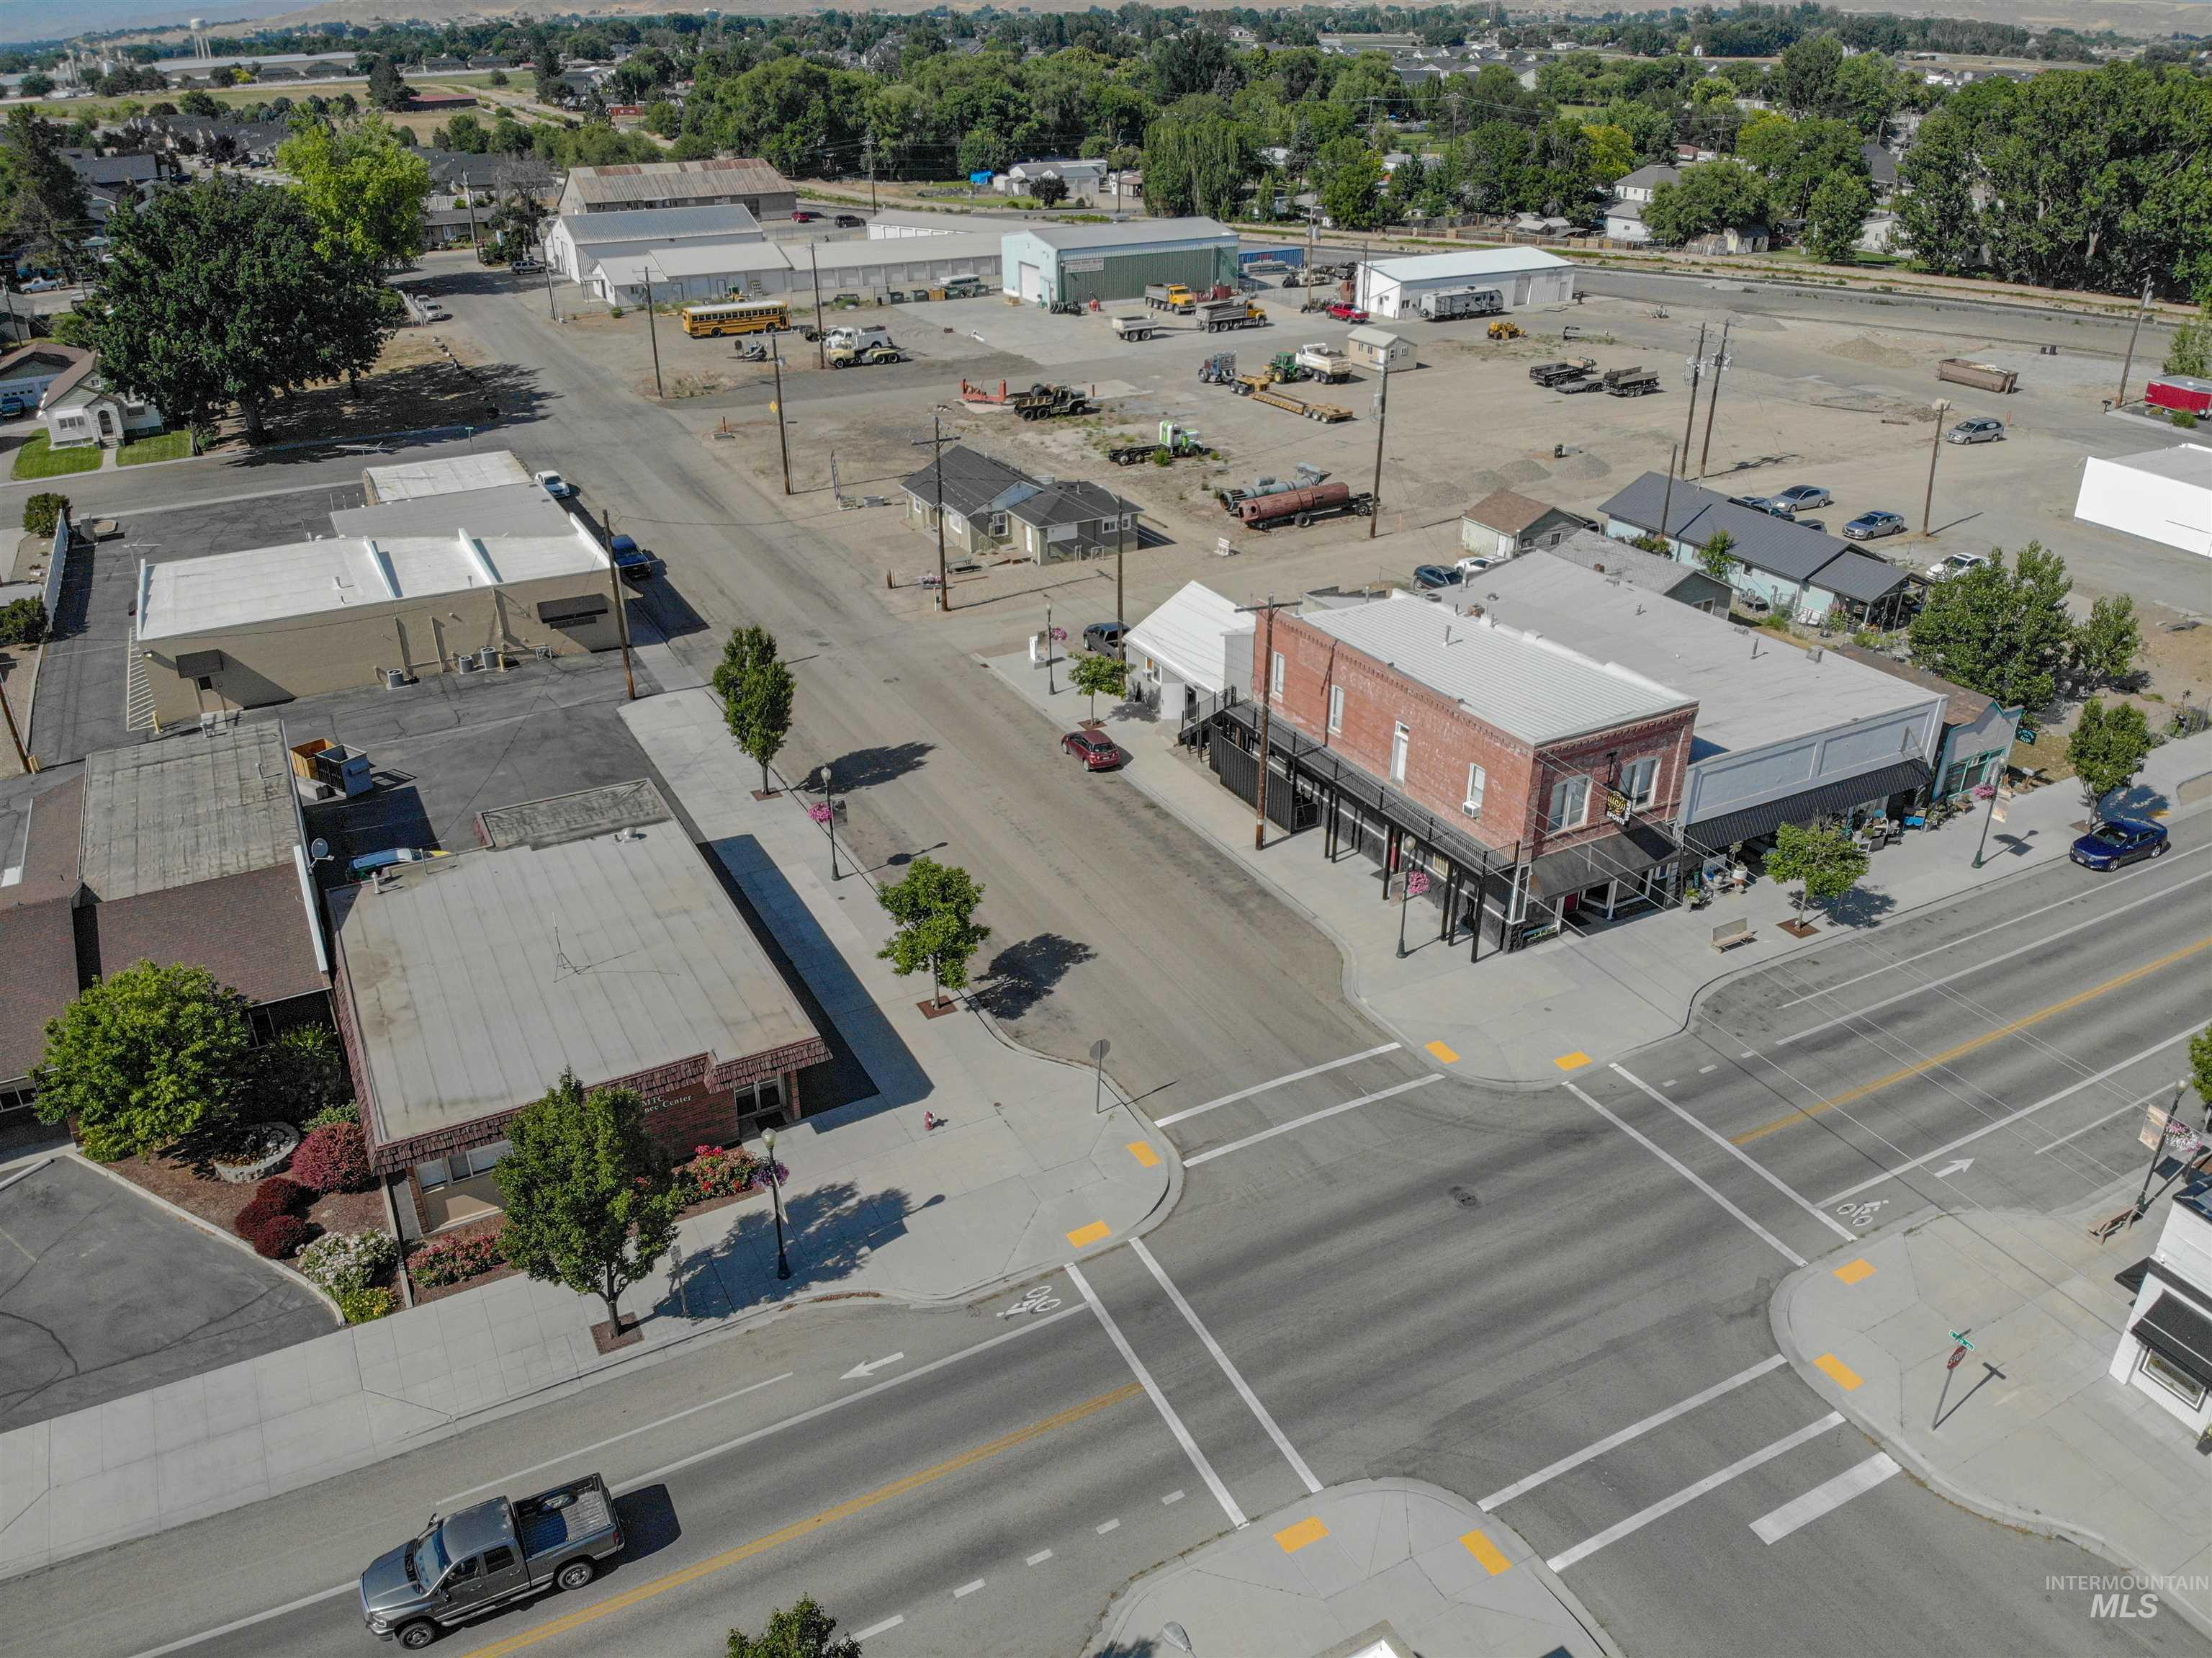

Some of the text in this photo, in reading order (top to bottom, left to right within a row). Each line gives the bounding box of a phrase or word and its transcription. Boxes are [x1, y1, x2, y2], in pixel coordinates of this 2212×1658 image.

[1606, 810, 1625, 825] SPORTS
[642, 1095, 665, 1108] MTC
[662, 1095, 692, 1108] Center
[1948, 1348, 1966, 1366] STOP
